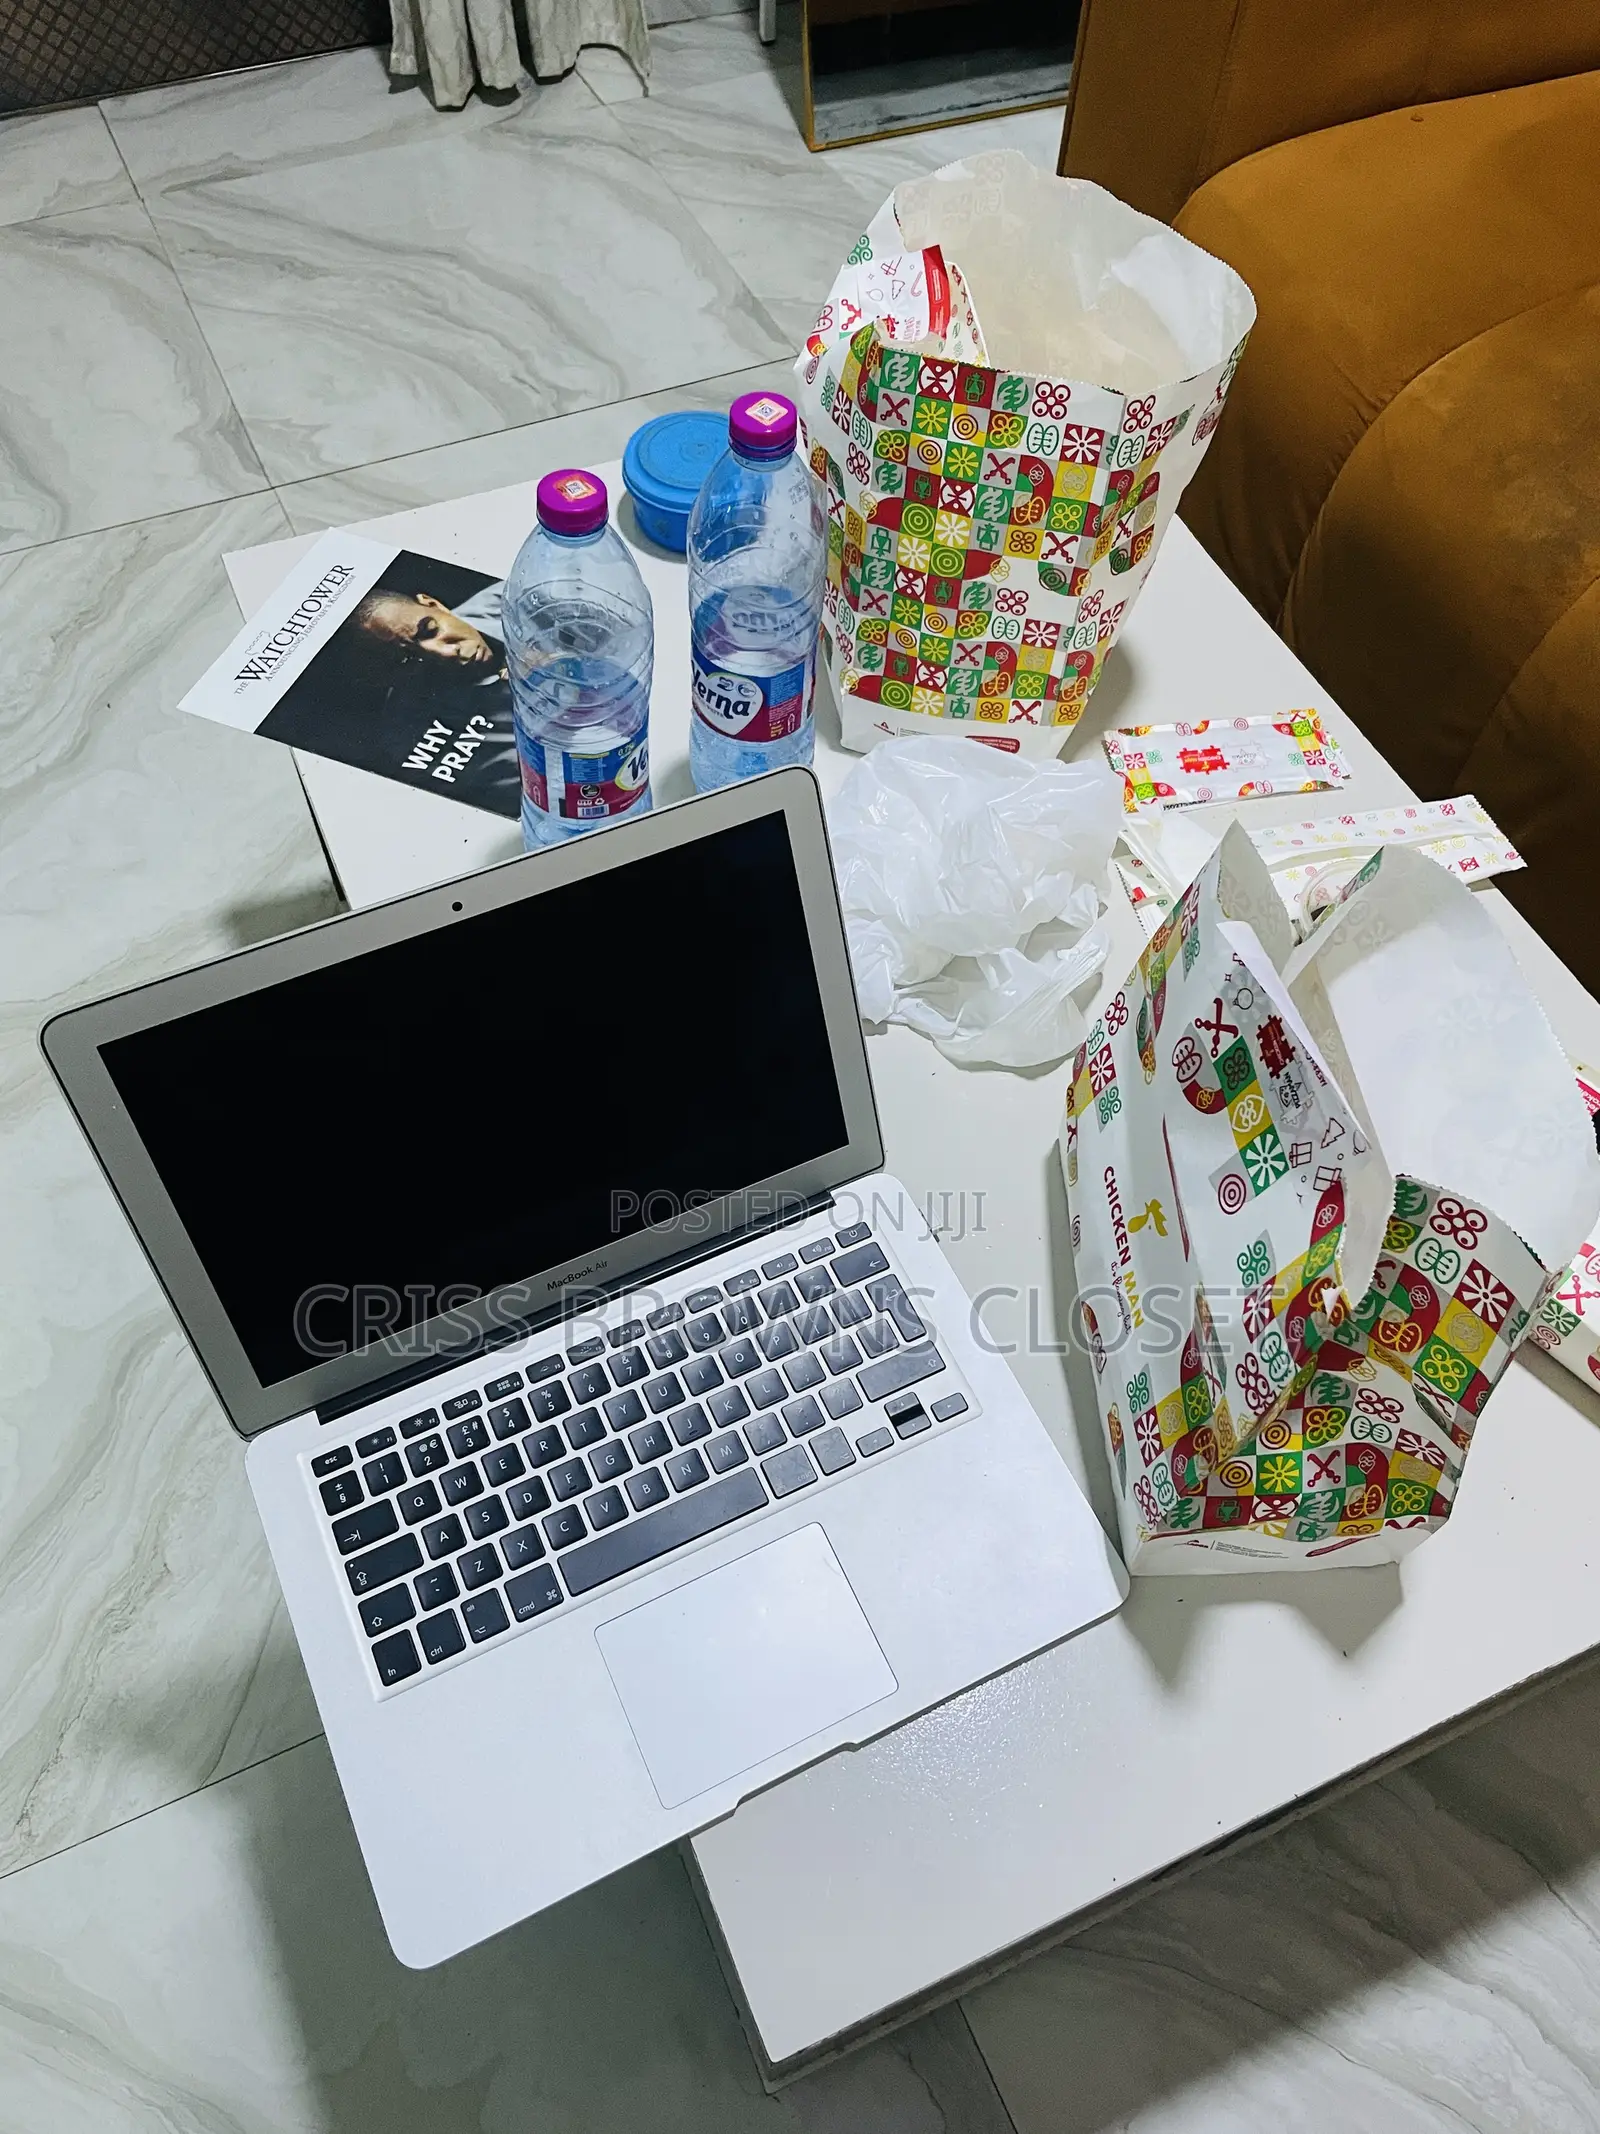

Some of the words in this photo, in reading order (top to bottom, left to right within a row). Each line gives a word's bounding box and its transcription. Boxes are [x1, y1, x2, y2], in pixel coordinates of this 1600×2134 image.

[234, 564, 355, 681] WATCHTOWER
[234, 680, 249, 695] THE
[401, 719, 453, 770] WHY
[431, 715, 494, 783] PRAY?
[1103, 1165, 1131, 1267] CHICKEN
[1123, 1270, 1145, 1329] MAN
[546, 1266, 594, 1291] MacBook
[595, 1260, 609, 1271] Air
[703, 1332, 710, 1341] 9
[772, 1335, 781, 1346] P
[666, 1349, 673, 1358] 8
[734, 1352, 745, 1363] O
[626, 1366, 633, 1376] 7
[588, 1384, 595, 1393] 6
[657, 1385, 668, 1397] U
[762, 1384, 770, 1394] L
[547, 1402, 555, 1412] 5
[619, 1404, 627, 1415] Y
[723, 1399, 733, 1411] K
[508, 1419, 515, 1429] 4
[579, 1422, 588, 1433] T
[687, 1418, 693, 1430] J
[466, 1437, 474, 1448] 3
[539, 1440, 549, 1452] R
[644, 1435, 655, 1448] H
[719, 1445, 733, 1458] M
[324, 1455, 338, 1465] esc
[424, 1455, 433, 1466] 2
[498, 1458, 507, 1470] E
[605, 1454, 615, 1466] G
[680, 1463, 692, 1477] N
[382, 1474, 389, 1484] 1
[454, 1476, 467, 1489] W
[564, 1472, 573, 1484] F
[641, 1483, 651, 1495] B
[413, 1496, 425, 1508] Q
[522, 1492, 533, 1504] D
[600, 1501, 609, 1513] V
[481, 1511, 490, 1523] S
[559, 1520, 570, 1532] C
[439, 1530, 450, 1543] A
[516, 1540, 528, 1553] X
[474, 1559, 485, 1573] Z
[466, 1604, 475, 1613] alt
[518, 1601, 535, 1615] cmd
[430, 1645, 443, 1657] ctrl
[387, 1667, 397, 1677] fn
